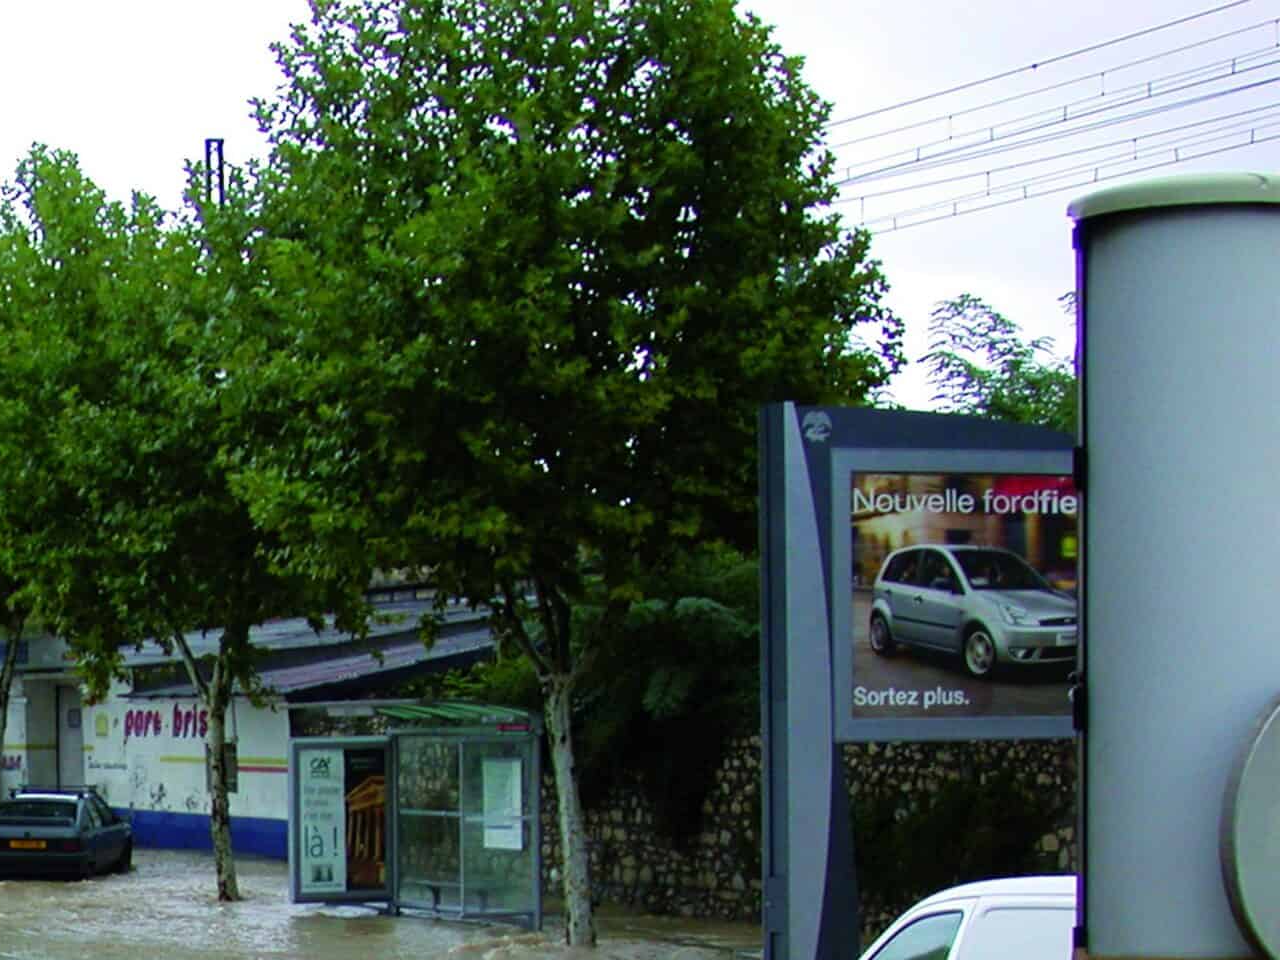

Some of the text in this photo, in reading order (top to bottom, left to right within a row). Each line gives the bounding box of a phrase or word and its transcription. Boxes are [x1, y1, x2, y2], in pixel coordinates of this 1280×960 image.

[853, 488, 974, 513] Nouvelle
[853, 687, 969, 710] Sortez plus.
